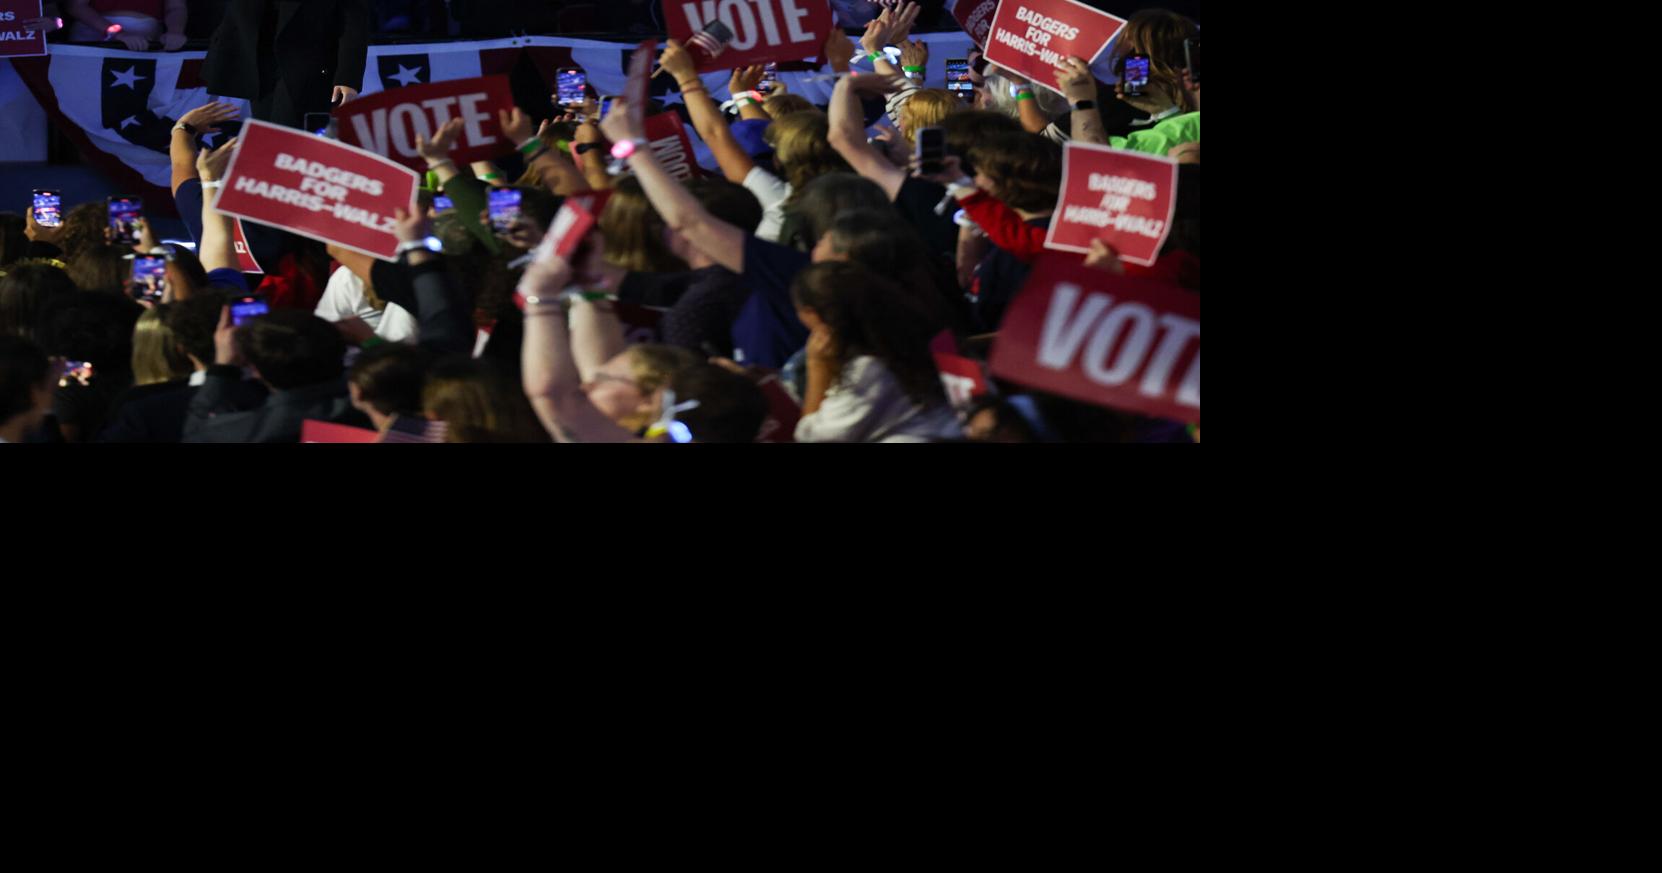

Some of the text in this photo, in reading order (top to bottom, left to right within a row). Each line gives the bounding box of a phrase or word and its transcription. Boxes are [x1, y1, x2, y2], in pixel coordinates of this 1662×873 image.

[682, 0, 816, 50] VOTE
[1015, 6, 1080, 41] BADGERS
[1025, 27, 1052, 47] FOR
[352, 92, 496, 159] VOTE
[274, 152, 384, 196] BADGERS
[300, 176, 348, 203] FOR
